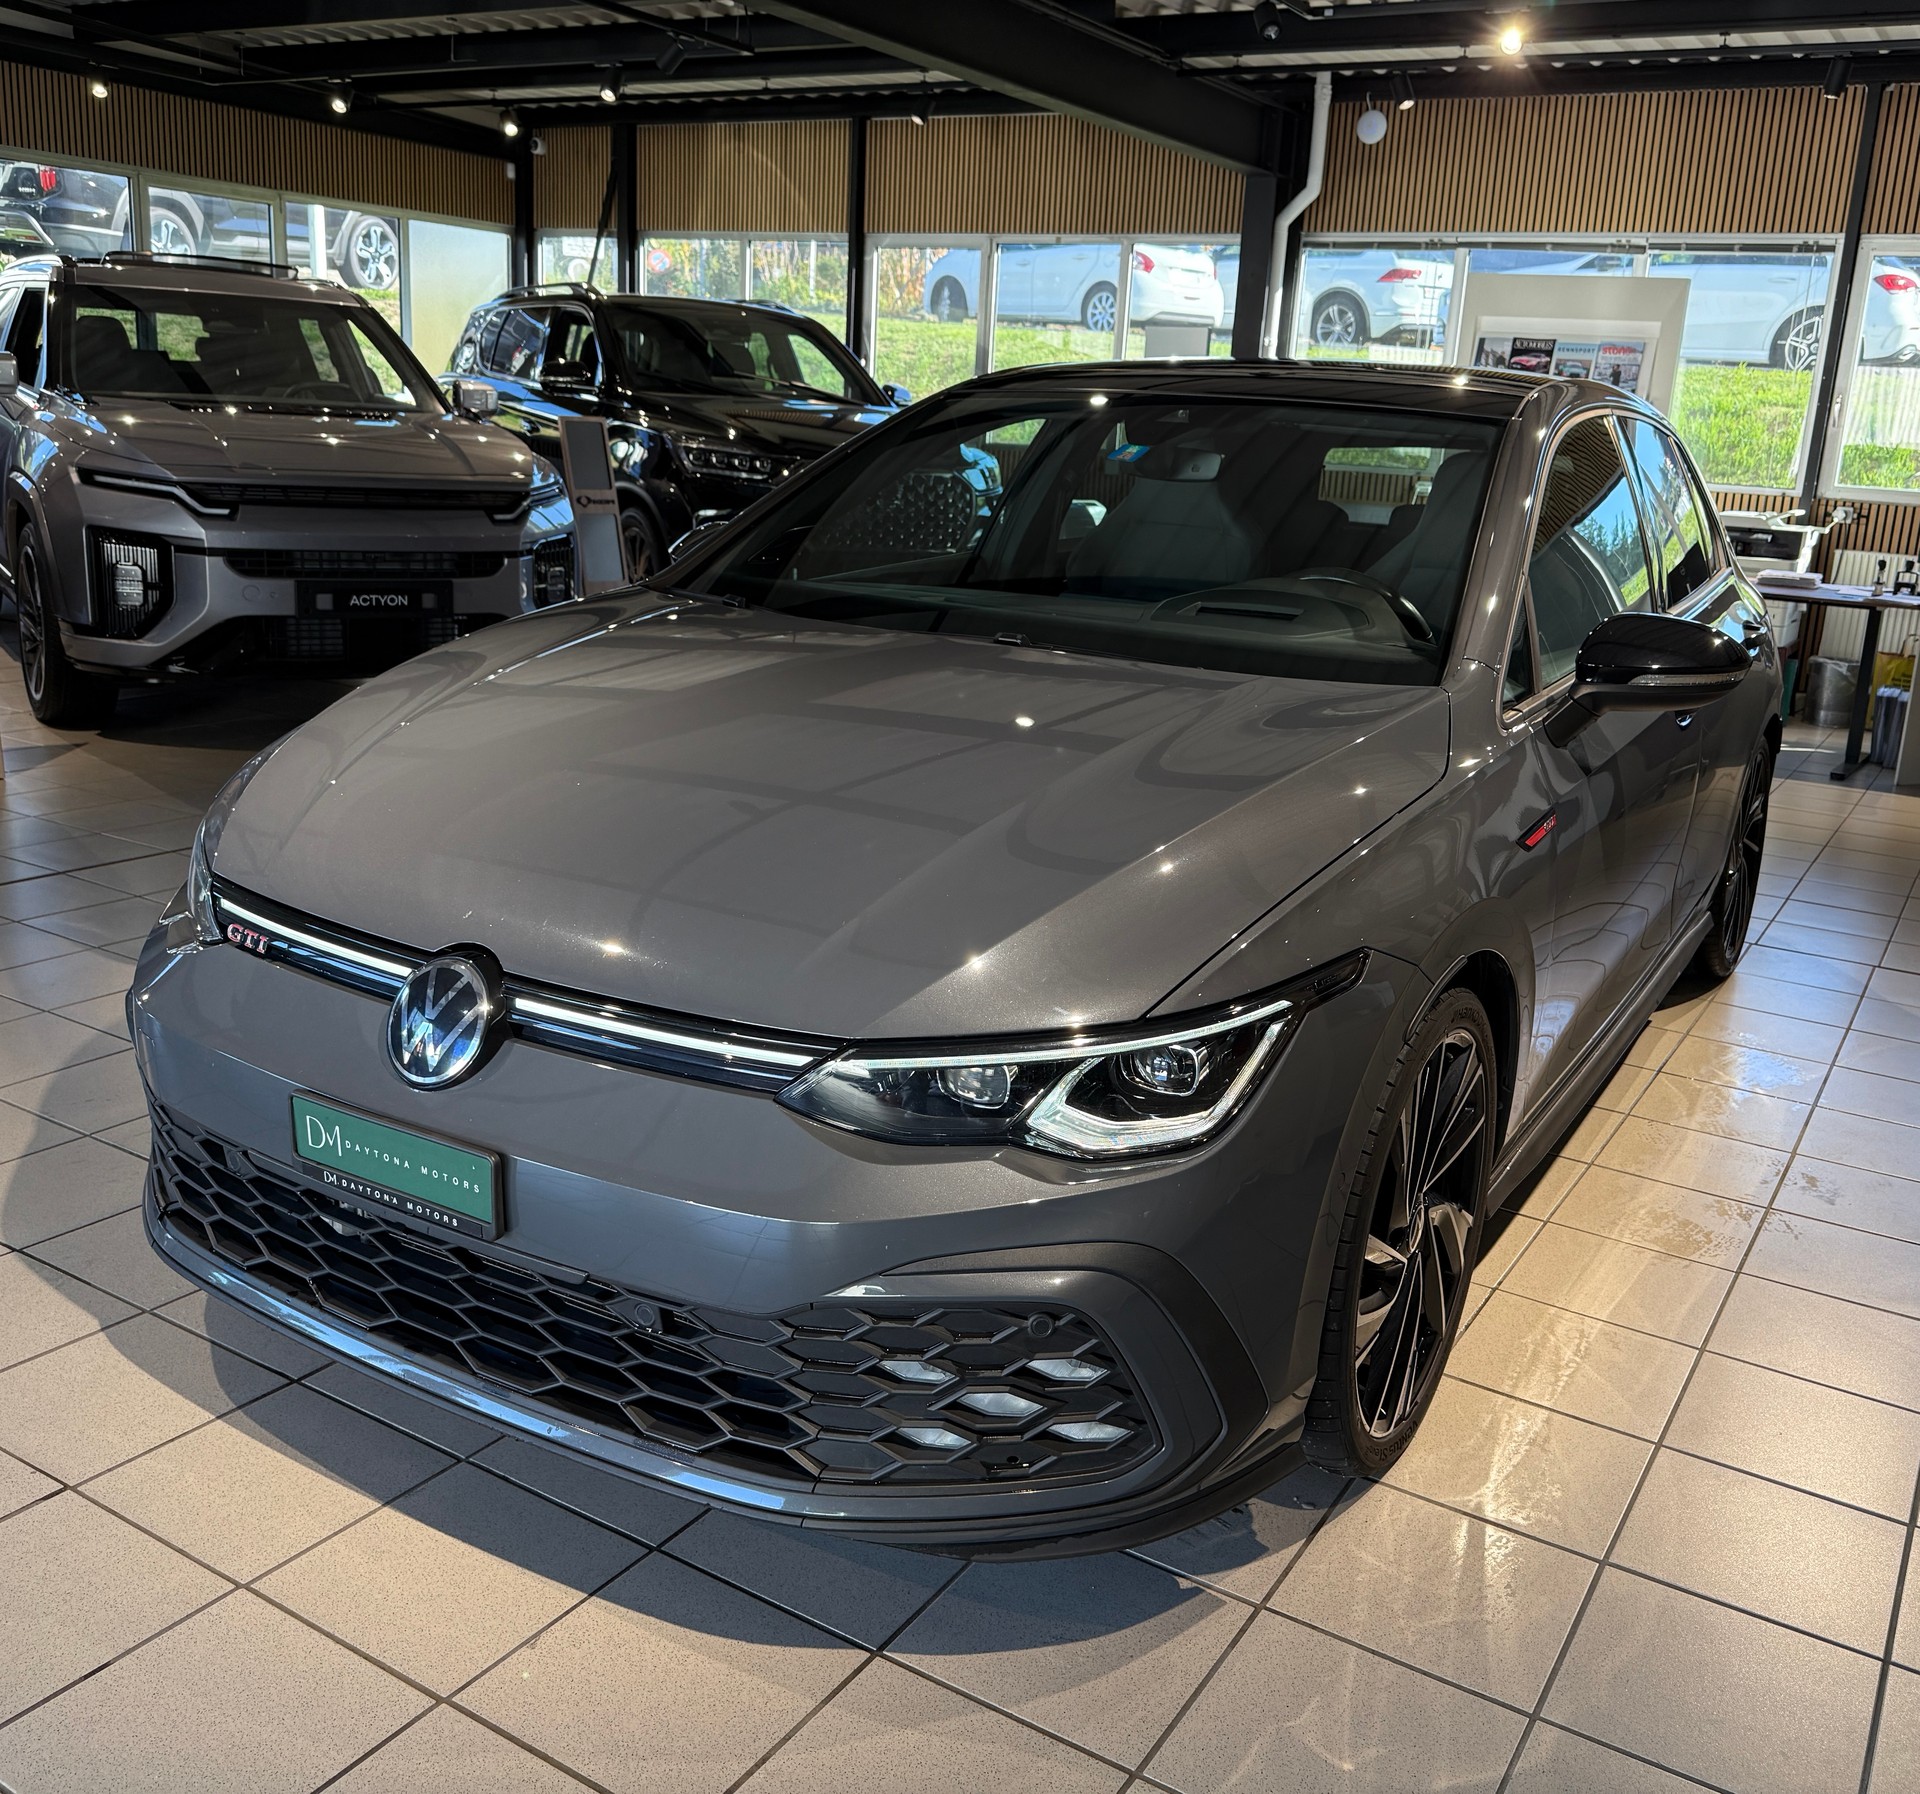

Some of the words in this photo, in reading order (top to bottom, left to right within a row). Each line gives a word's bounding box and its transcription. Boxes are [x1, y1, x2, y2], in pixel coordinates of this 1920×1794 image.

[350, 594, 408, 606] ACTYON
[227, 923, 269, 954] GTI
[346, 1140, 410, 1169] DAYTONA
[420, 1165, 480, 1193] MOTORS
[342, 1179, 398, 1205] DAYTONA
[406, 1201, 459, 1227] MOTORS
